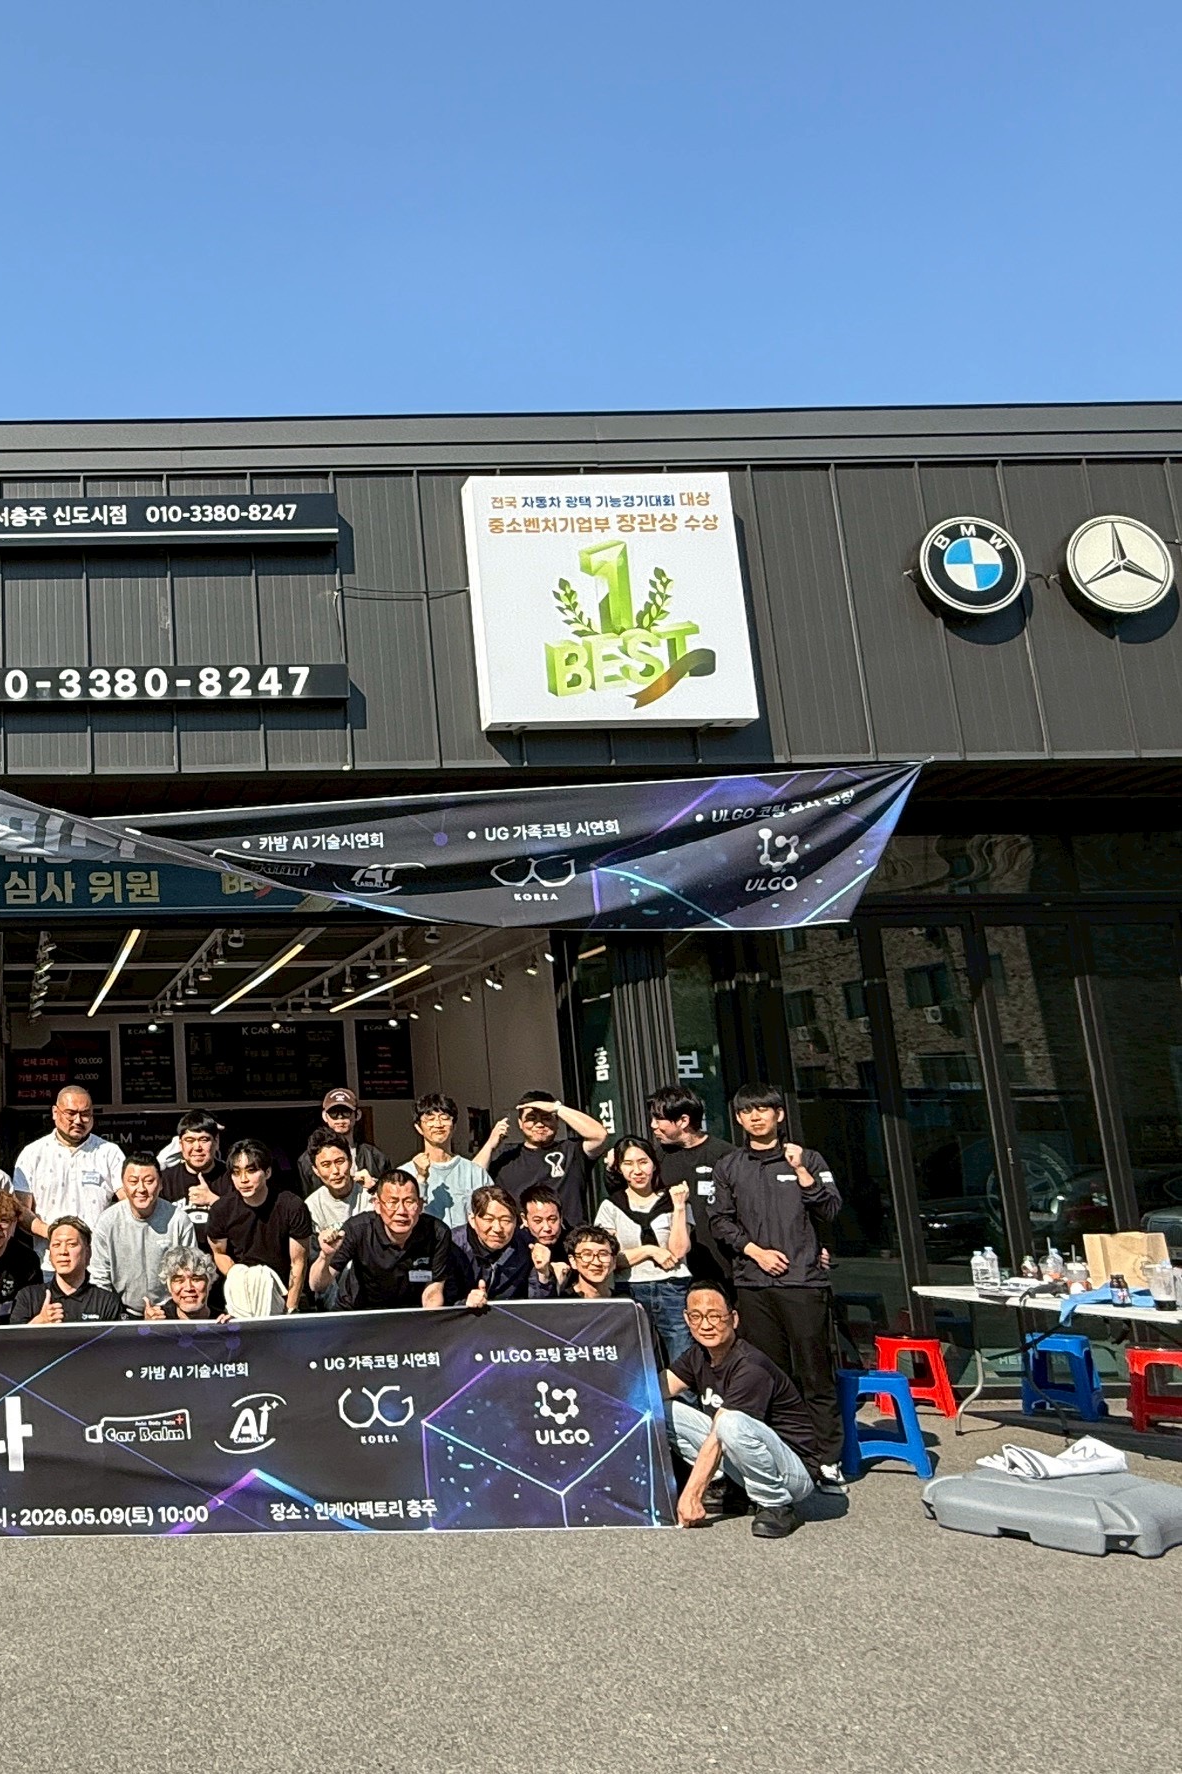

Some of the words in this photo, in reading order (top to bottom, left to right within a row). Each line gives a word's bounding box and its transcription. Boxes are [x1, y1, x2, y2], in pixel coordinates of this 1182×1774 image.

[491, 496, 517, 509] 전국
[521, 495, 561, 509] 자동차
[565, 495, 592, 508] 광택
[596, 494, 675, 508] 기능경기대회
[680, 491, 711, 507] 대상
[53, 504, 128, 526] 신도시점
[146, 503, 297, 523] 010-3380-8247
[488, 516, 611, 534] 중소벤처기업부
[616, 512, 678, 533] 장관상
[684, 514, 718, 532] 수상
[933, 523, 1008, 551] BMW
[544, 620, 700, 697] BEST
[711, 808, 755, 822] ULGO
[485, 826, 509, 841] UG
[576, 819, 620, 837] 시연회
[259, 836, 288, 852] 카밤
[292, 835, 308, 849] AI
[312, 832, 385, 850] 기술시연회
[4, 870, 76, 904] 심사
[88, 870, 161, 903] 위원
[745, 875, 798, 892] ULGO
[513, 893, 559, 902] KOREA
[324, 1358, 345, 1371] UG
[402, 1352, 440, 1367] 시연회
[490, 1349, 532, 1363] ULGO
[535, 1347, 561, 1363] 코팅
[563, 1346, 590, 1361] 공식
[592, 1345, 618, 1361] 런칭
[140, 1365, 166, 1380] 카밤
[169, 1367, 183, 1378] AI
[186, 1362, 249, 1379] 기술시연회
[105, 1427, 136, 1442] Car
[139, 1426, 185, 1441] Balm
[360, 1434, 398, 1445] KOREA
[536, 1428, 590, 1445] ULGO
[20, 1506, 154, 1527] 2026.05.09(토)
[157, 1505, 209, 1523] 10:00
[270, 1503, 302, 1522] 장소
[313, 1500, 404, 1521] 인케어팩토리
[406, 1499, 438, 1517] 충주
